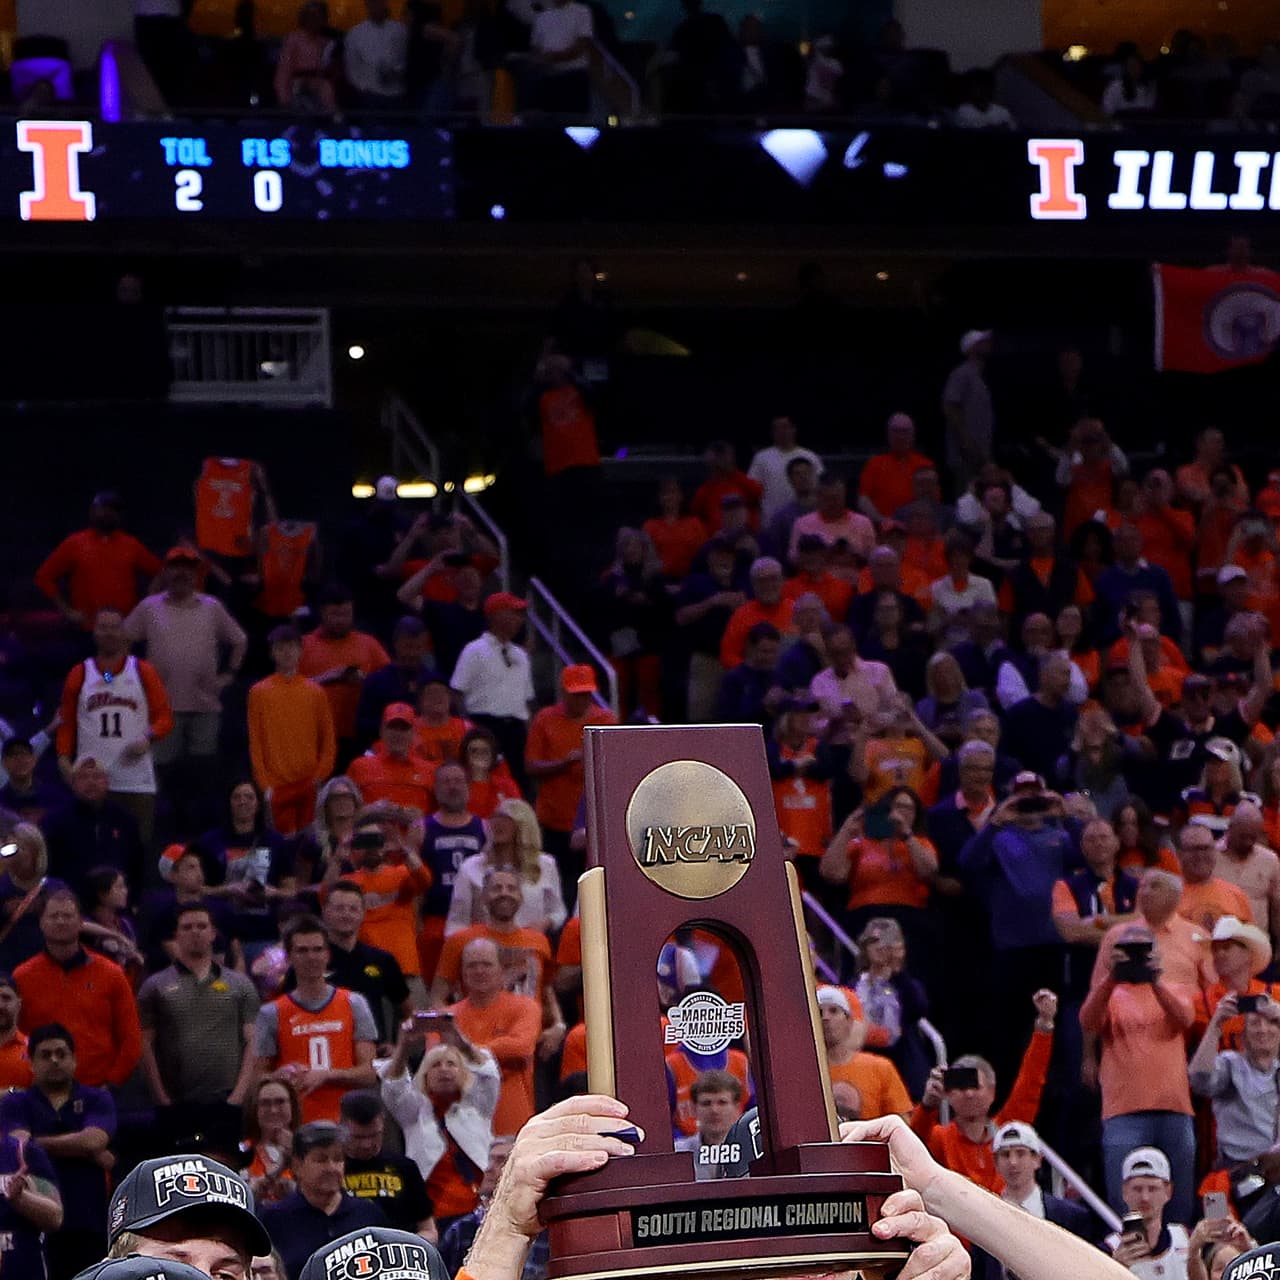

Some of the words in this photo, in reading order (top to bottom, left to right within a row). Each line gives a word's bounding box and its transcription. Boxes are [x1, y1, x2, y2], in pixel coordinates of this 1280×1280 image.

[160, 137, 214, 167] TOL
[242, 138, 291, 168] FLS
[320, 138, 410, 168] BONUS
[174, 171, 203, 211] 2
[254, 170, 283, 212] 0
[100, 713, 122, 737] 11
[646, 824, 755, 863] NCAA
[682, 1007, 722, 1022] MARCH
[689, 1021, 743, 1035] MADNESS
[309, 1037, 330, 1070] 0
[154, 1160, 208, 1179] FINAL
[700, 1144, 740, 1165] 2026
[637, 1207, 696, 1238] SOUTH
[702, 1203, 782, 1231] REGIONAL
[785, 1200, 862, 1227] CHAMPION
[326, 1235, 379, 1270] FINAL
[1231, 1254, 1275, 1279] FINAL
